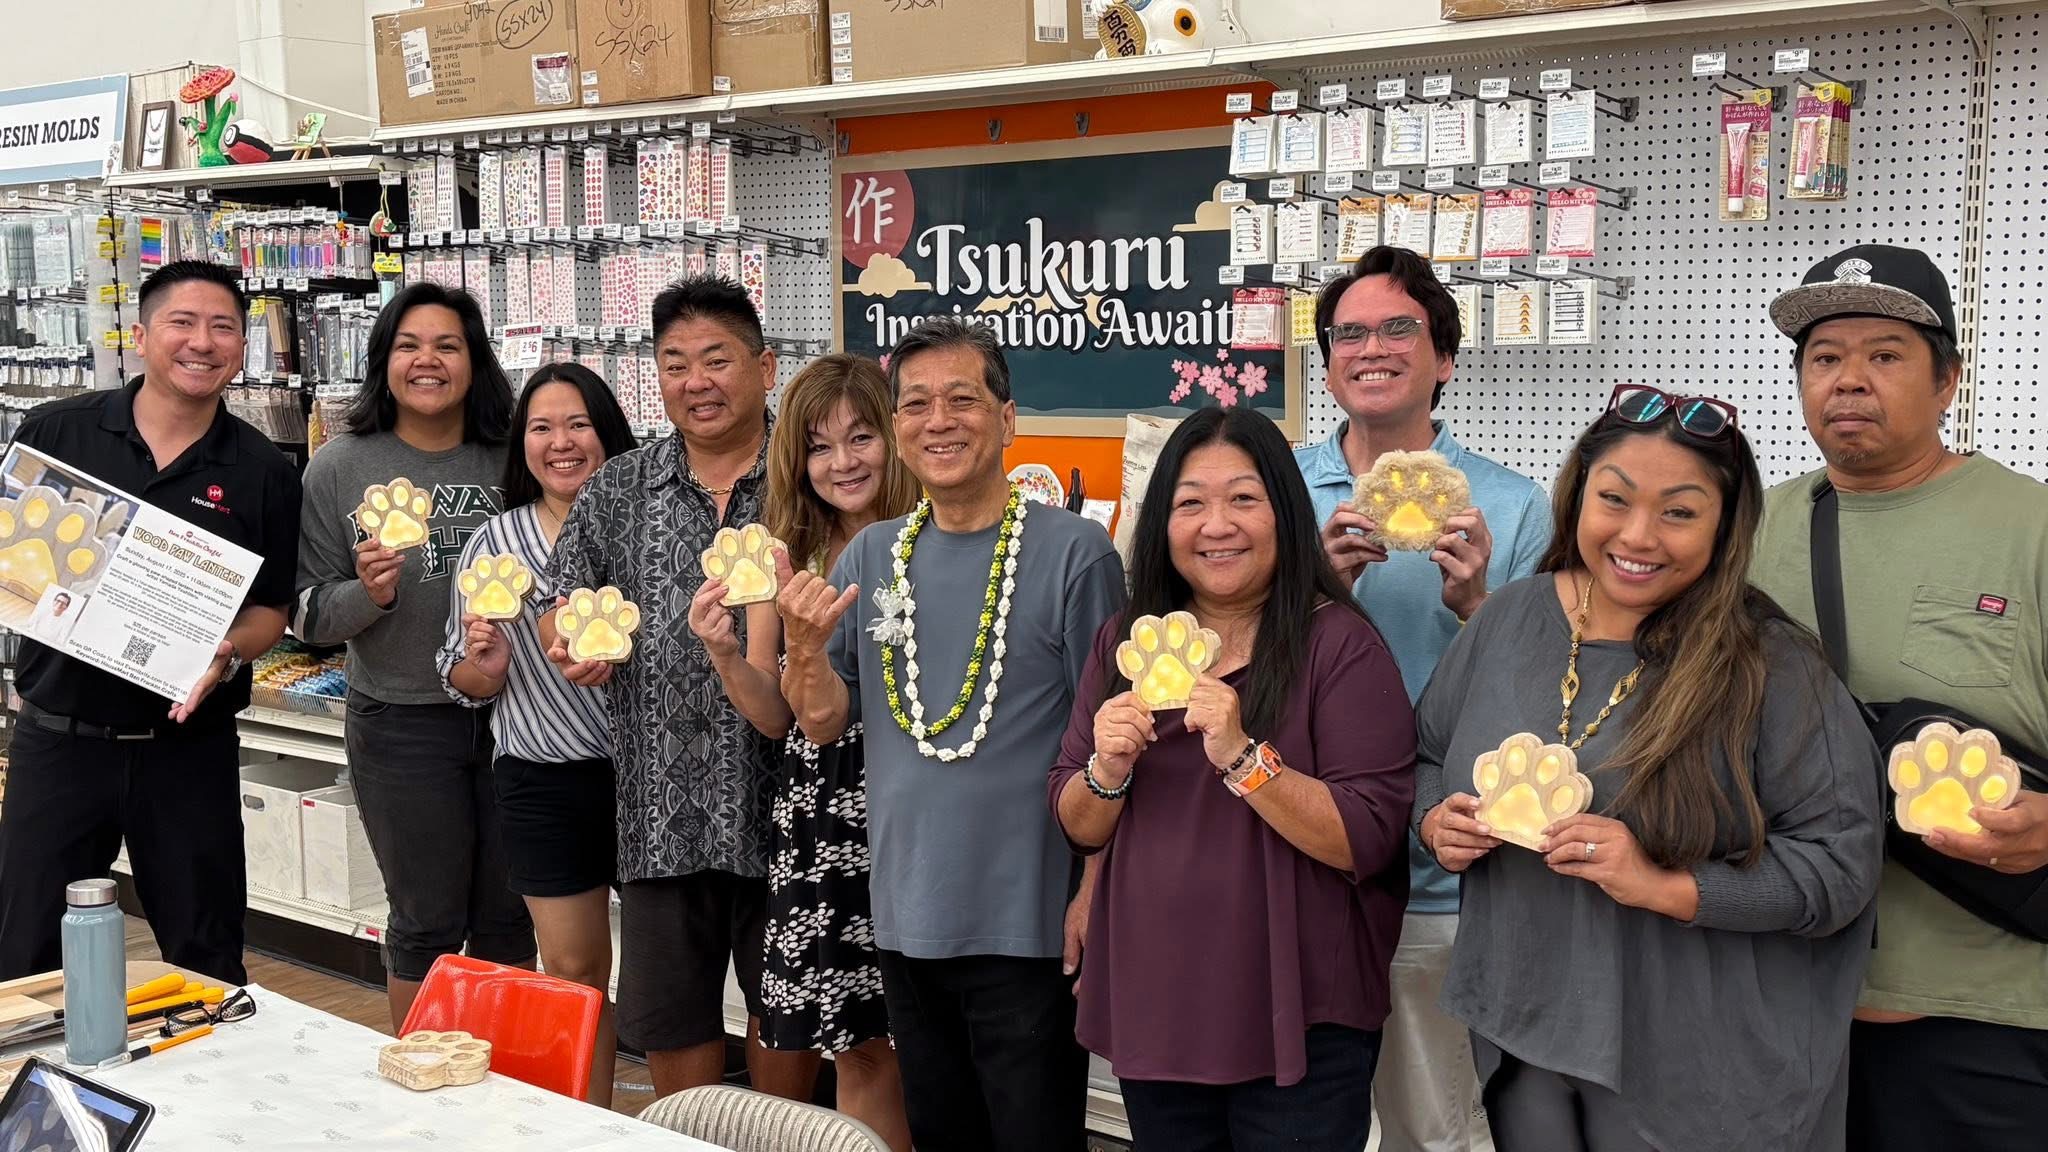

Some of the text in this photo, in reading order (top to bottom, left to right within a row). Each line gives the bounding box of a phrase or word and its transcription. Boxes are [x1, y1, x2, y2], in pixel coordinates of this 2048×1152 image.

[0, 116, 100, 149] ESIN MOLDS
[844, 175, 896, 244] 作
[916, 217, 1190, 310] Tsukuru
[133, 526, 246, 587] WOOD PAW LANTERN
[144, 555, 165, 569] August
